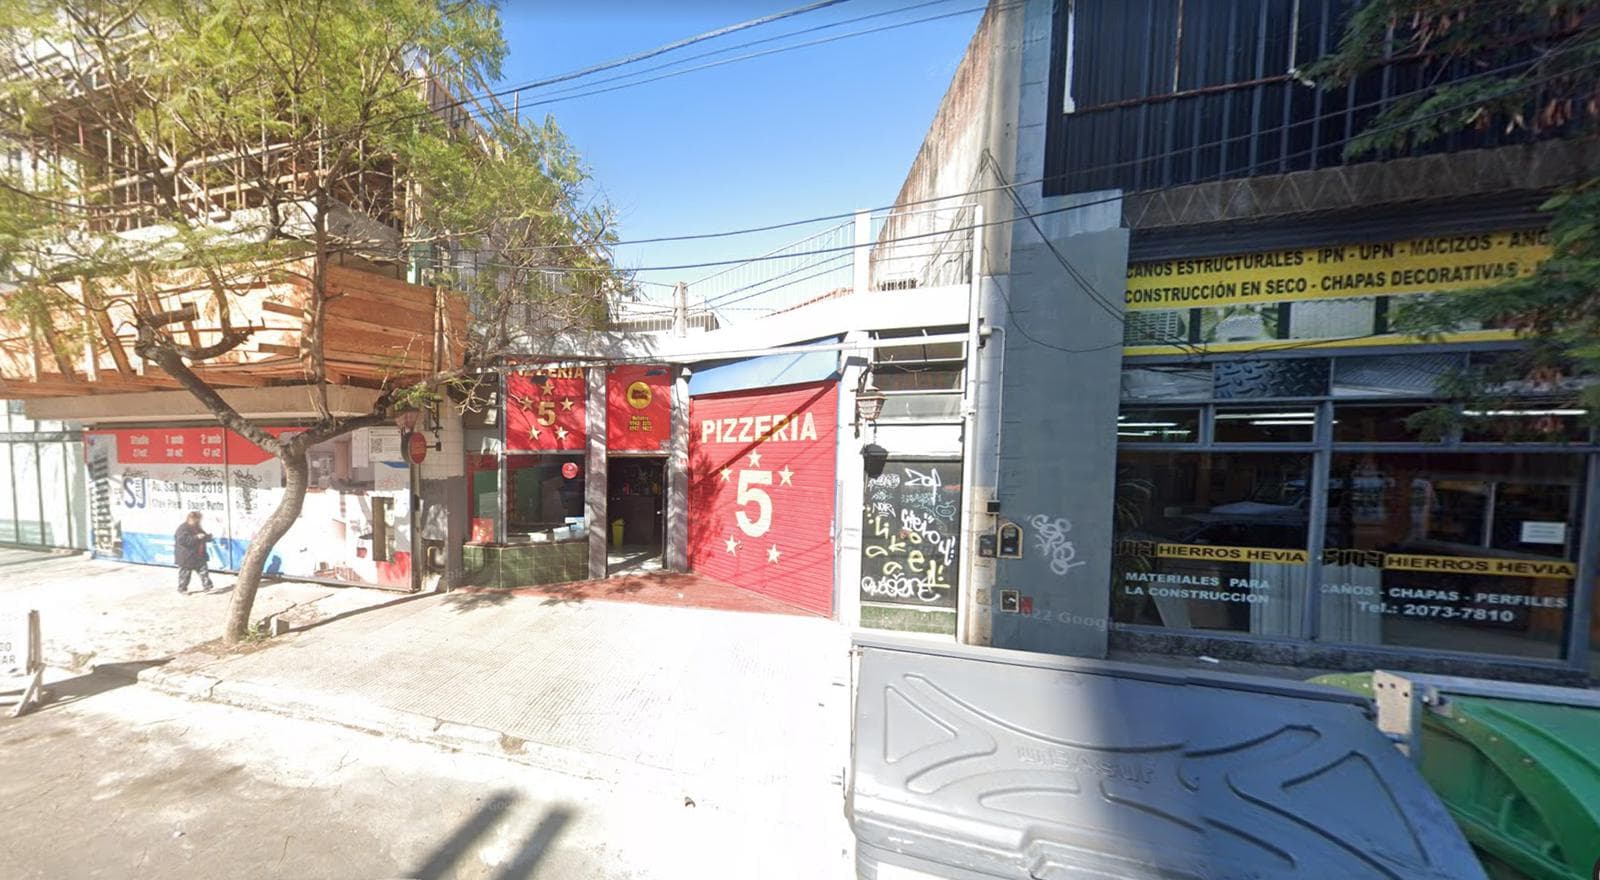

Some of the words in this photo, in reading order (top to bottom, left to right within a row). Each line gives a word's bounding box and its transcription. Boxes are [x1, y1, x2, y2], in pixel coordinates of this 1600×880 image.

[1177, 249, 1304, 276] ESTRUCTURALES
[1317, 247, 1344, 264] IPN
[1359, 242, 1394, 260] UPN
[1410, 235, 1491, 257] MACIZOS
[1125, 279, 1236, 303] CONSTRUCCIÓN
[1241, 281, 1260, 296] EN
[1265, 278, 1307, 294] SECO
[1321, 271, 1386, 290] CHAPAS
[1391, 262, 1519, 286] DECORATIVAS
[536, 401, 557, 426] 5
[701, 411, 817, 443] PIZZERIA
[201, 481, 223, 493] 2318
[735, 468, 774, 537] 5
[1160, 545, 1242, 559] HIERROS
[1246, 549, 1305, 562] HEVIA
[1387, 554, 1489, 571] HIERROS
[1496, 561, 1572, 576] HEVIA
[1125, 572, 1220, 586] MATERIALES
[1229, 577, 1270, 589] PARA
[1125, 586, 1144, 595] LA
[1149, 587, 1270, 603] CONSTRUCCION
[1389, 587, 1459, 601] CHAPAS
[1475, 592, 1568, 609] PERFILES
[1358, 601, 1398, 614] Tel.:
[1403, 603, 1515, 622] 2073-7810
